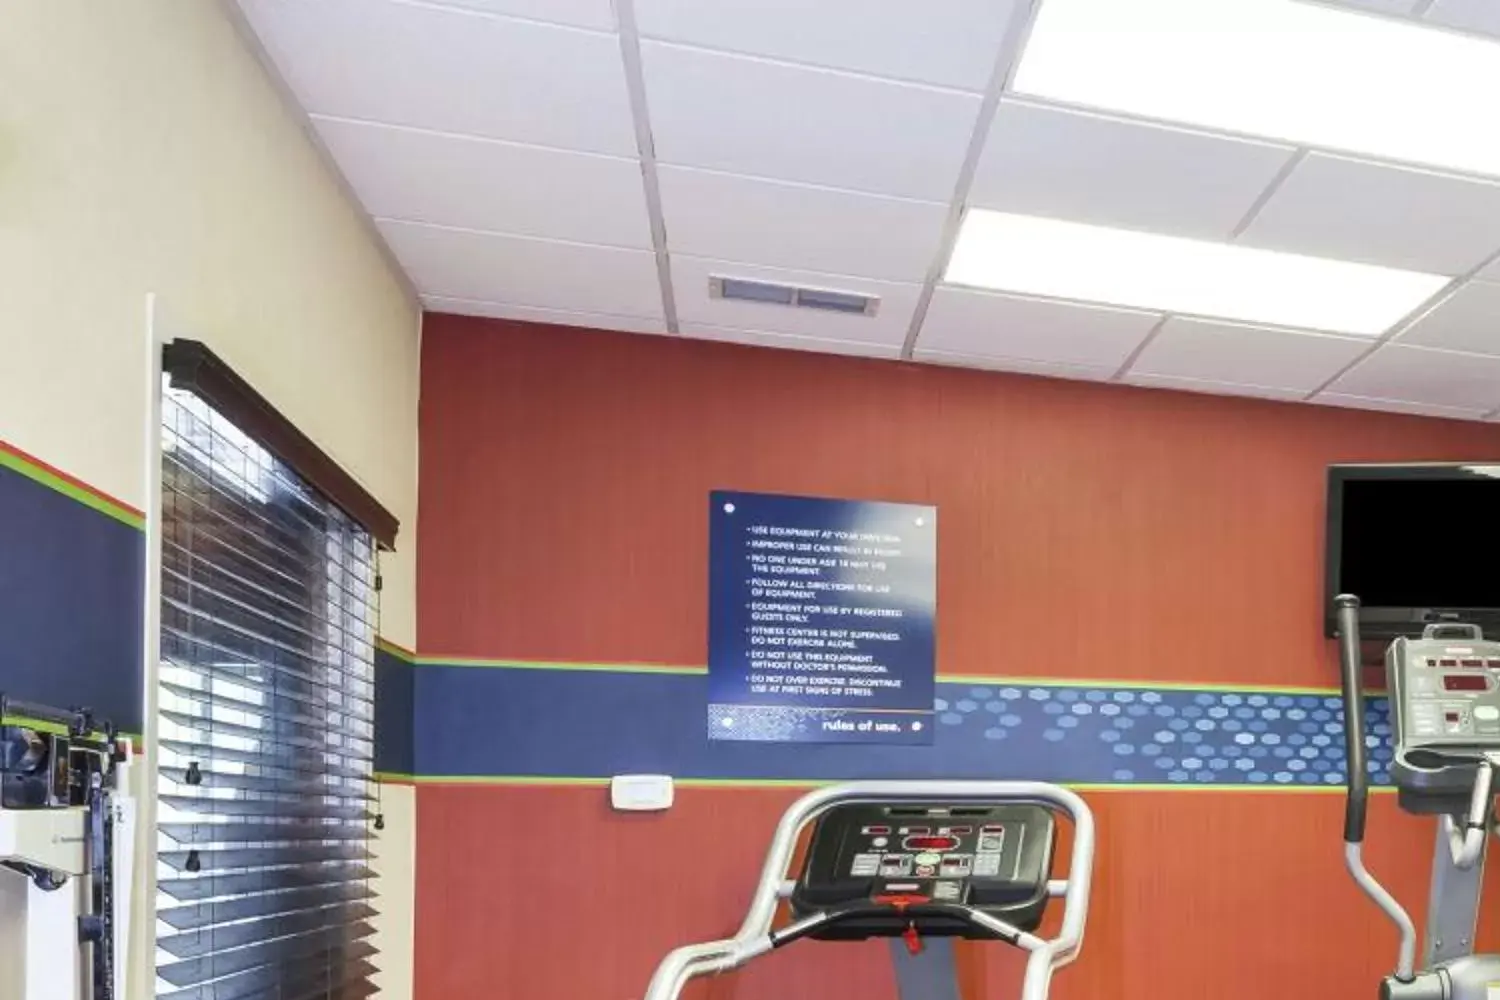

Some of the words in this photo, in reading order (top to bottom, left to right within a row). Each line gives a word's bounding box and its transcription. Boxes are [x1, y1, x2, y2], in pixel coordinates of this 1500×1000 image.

[770, 527, 820, 537] EQUIPMENT
[751, 554, 766, 563] NO
[768, 555, 786, 564] ONE
[752, 564, 768, 573] THE
[752, 577, 788, 587] FOLLOW
[789, 580, 804, 588] ALL
[751, 587, 763, 596] OF
[752, 602, 802, 612] EQUIPMENT
[804, 605, 821, 613] FOR
[752, 626, 784, 635] FITNESS
[786, 627, 818, 637] CENTER
[830, 629, 848, 638] NOT
[751, 635, 765, 644] DO
[767, 637, 785, 645] NOT
[751, 650, 764, 659] DO
[767, 651, 785, 659] NOT
[751, 660, 792, 669] WITHOUT
[751, 673, 764, 682] DO
[766, 675, 784, 683] NOT
[822, 720, 855, 731] rules
[857, 720, 872, 731] of
